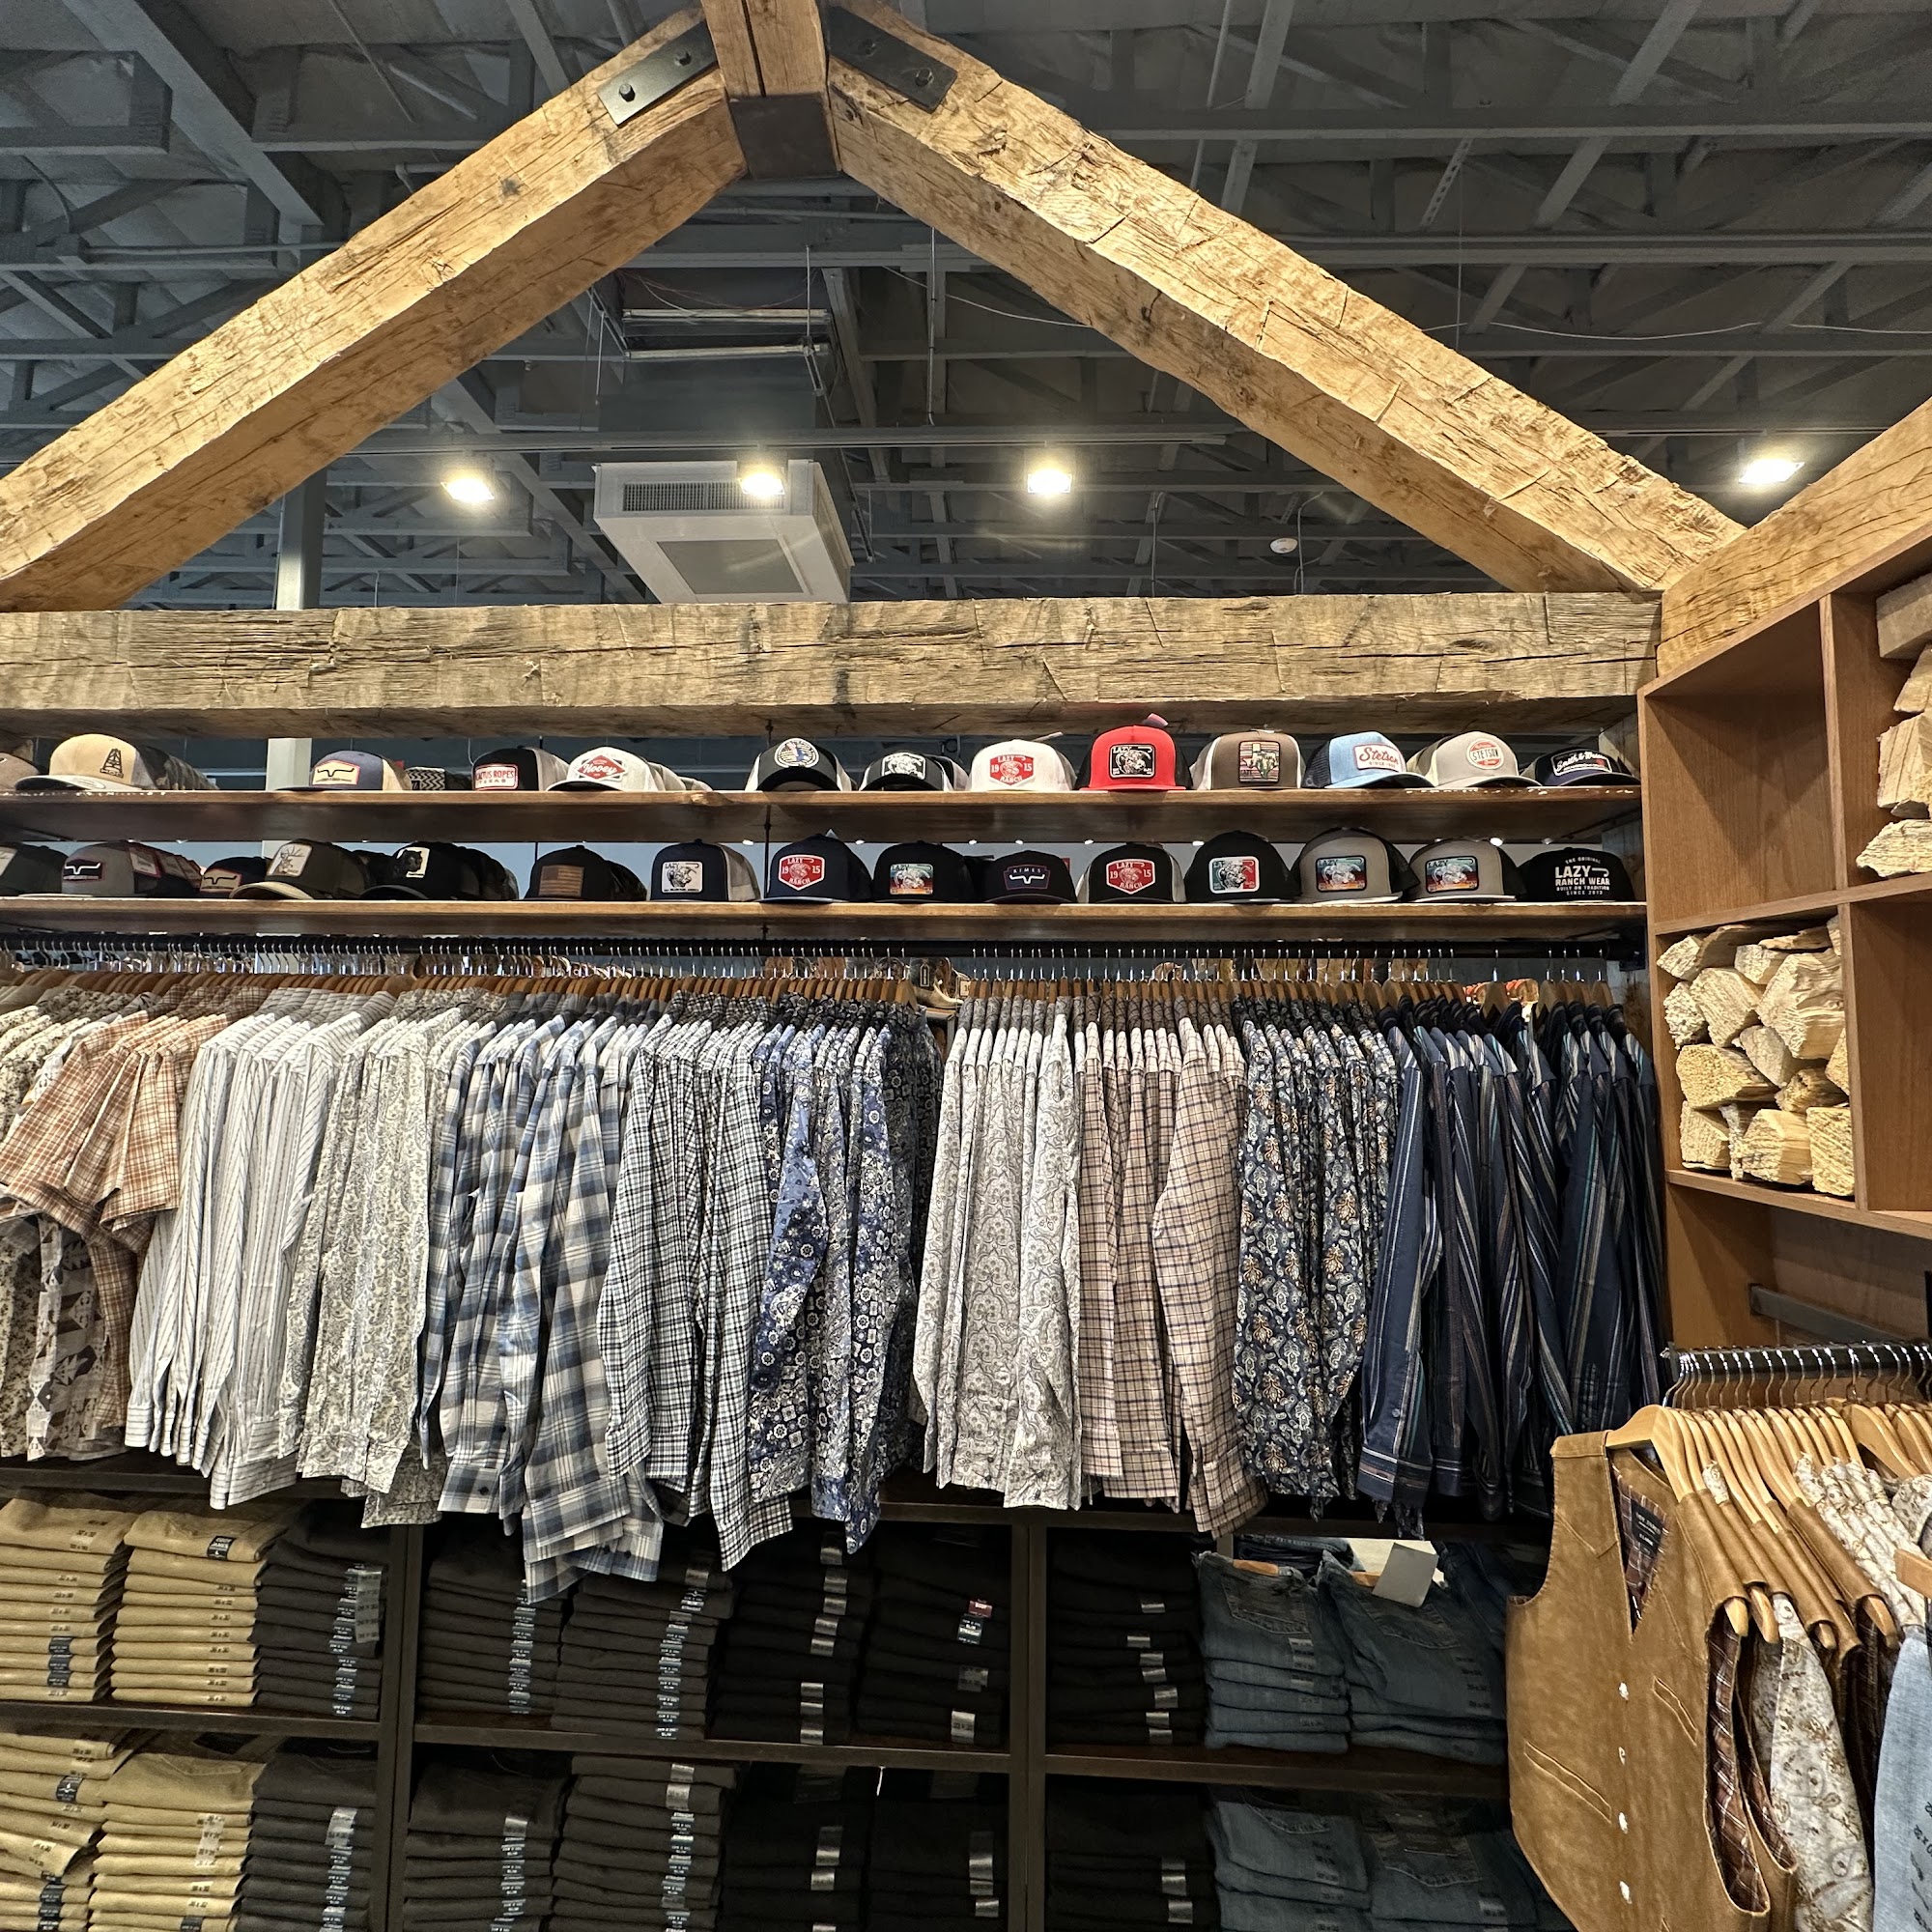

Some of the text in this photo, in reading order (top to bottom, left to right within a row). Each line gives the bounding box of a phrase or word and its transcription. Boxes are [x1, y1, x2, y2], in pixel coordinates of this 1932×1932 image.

[1359, 747, 1398, 764] Stetson
[1473, 749, 1499, 761] STETSON
[582, 763, 617, 776] Hooey
[991, 764, 999, 773] 19
[494, 770, 514, 779] ROPES
[782, 866, 789, 874] 19
[812, 866, 820, 874] 15
[1110, 870, 1118, 879] 19
[1555, 866, 1591, 878] LAZY
